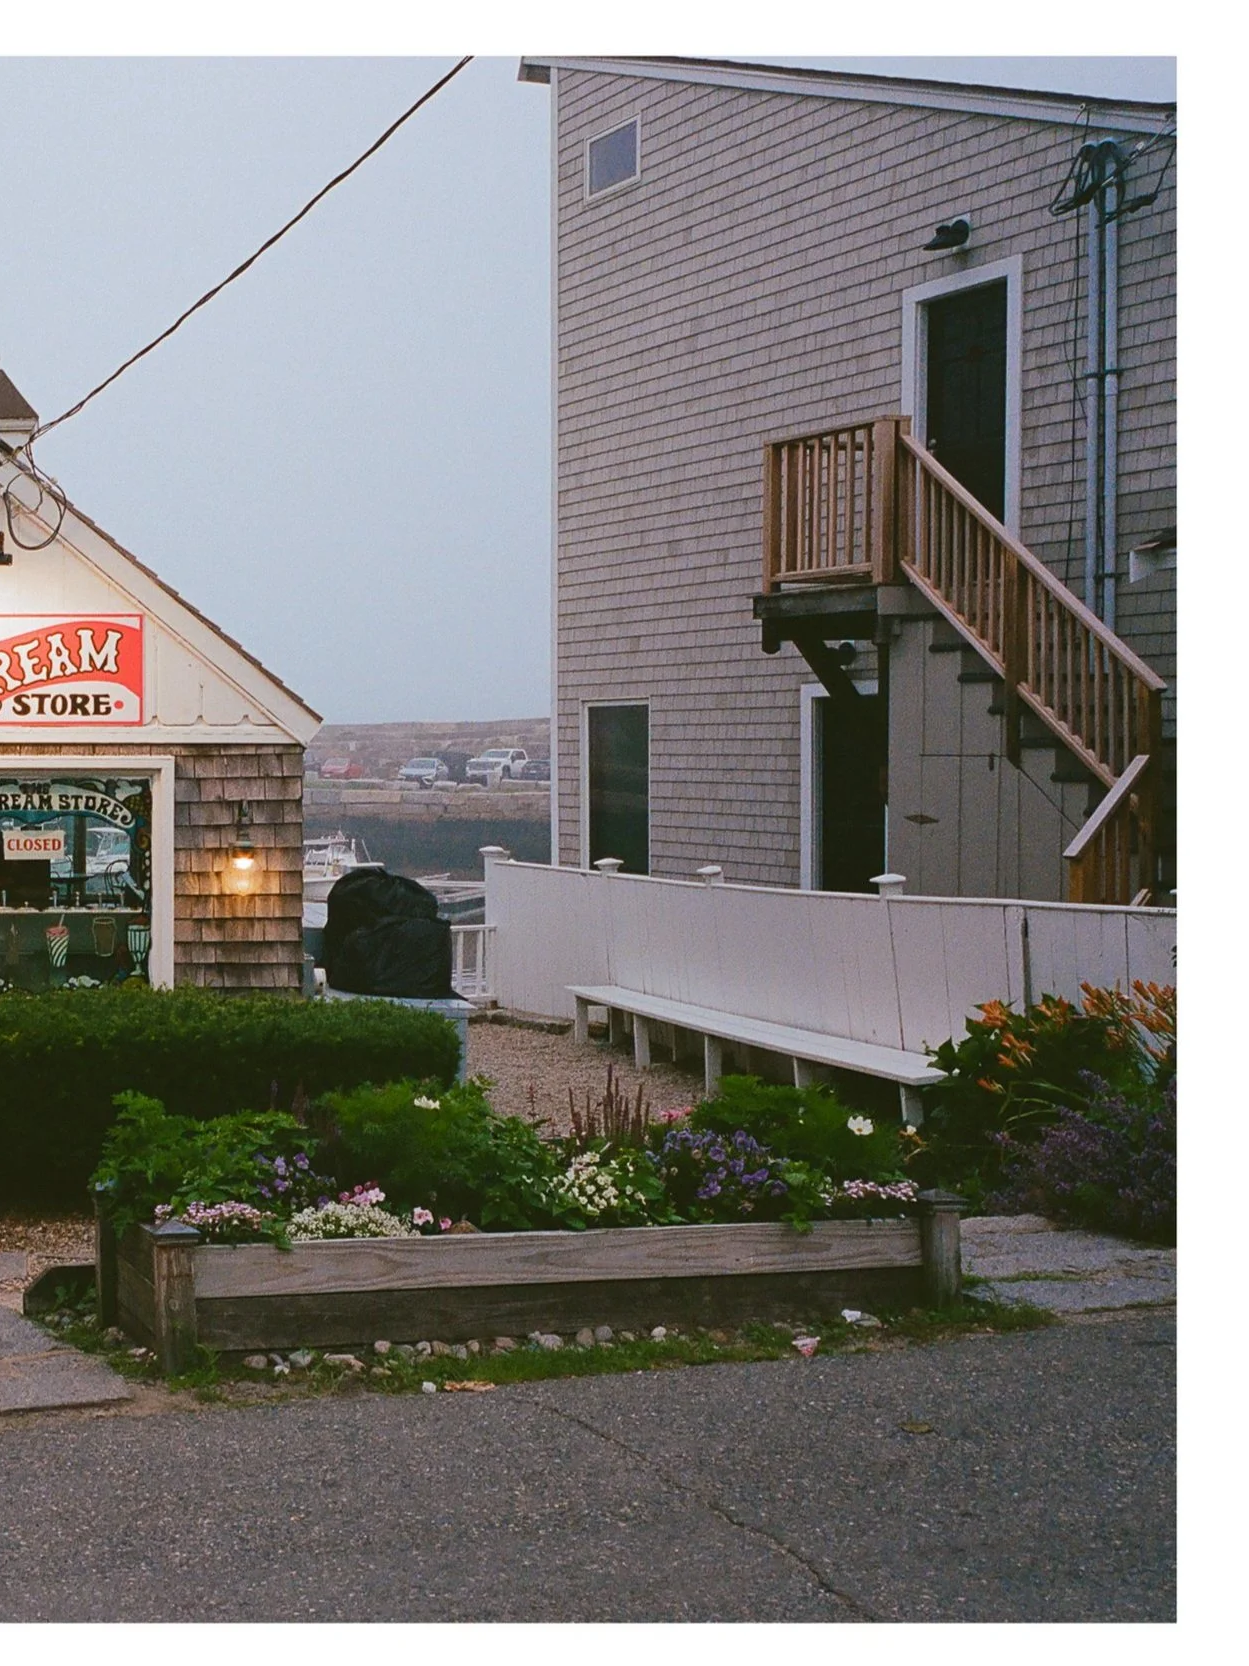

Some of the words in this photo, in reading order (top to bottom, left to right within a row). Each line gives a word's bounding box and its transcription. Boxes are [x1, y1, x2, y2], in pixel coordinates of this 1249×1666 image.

[12, 693, 112, 716] STORE
[58, 794, 124, 821] STORE
[7, 838, 62, 851] CLOSED
